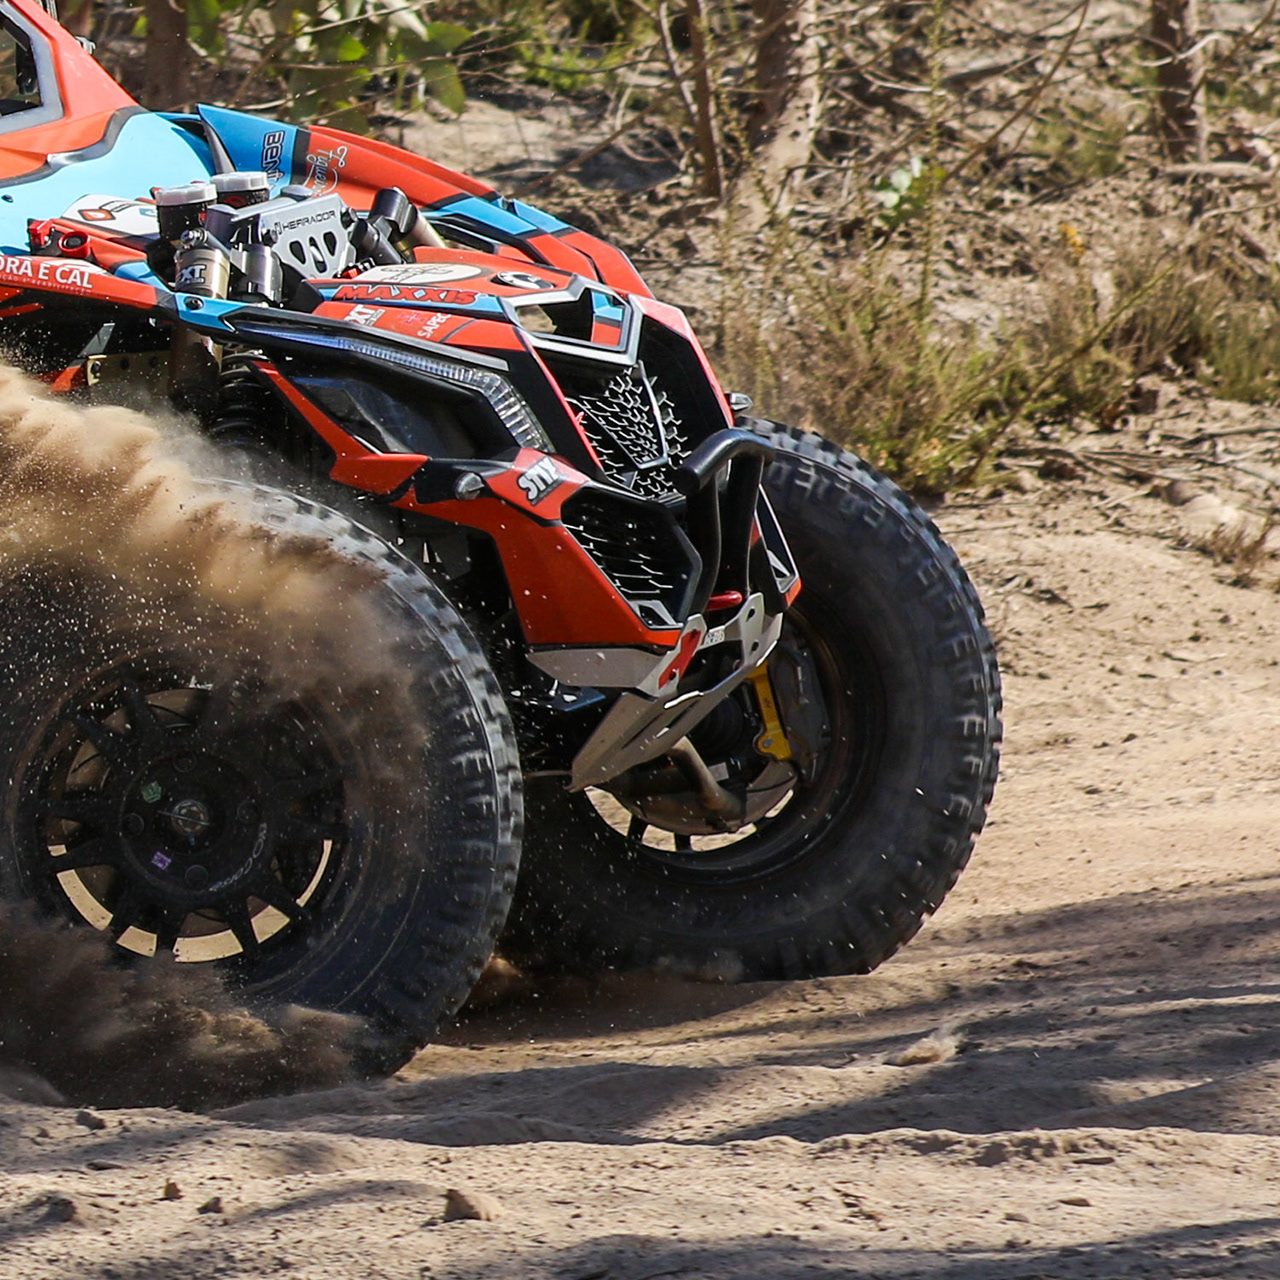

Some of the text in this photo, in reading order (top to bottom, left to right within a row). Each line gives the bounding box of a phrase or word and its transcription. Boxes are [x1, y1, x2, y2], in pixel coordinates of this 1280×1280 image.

[38, 262, 50, 280] E
[55, 267, 93, 288] CAL
[332, 284, 477, 305] MAXXIS
